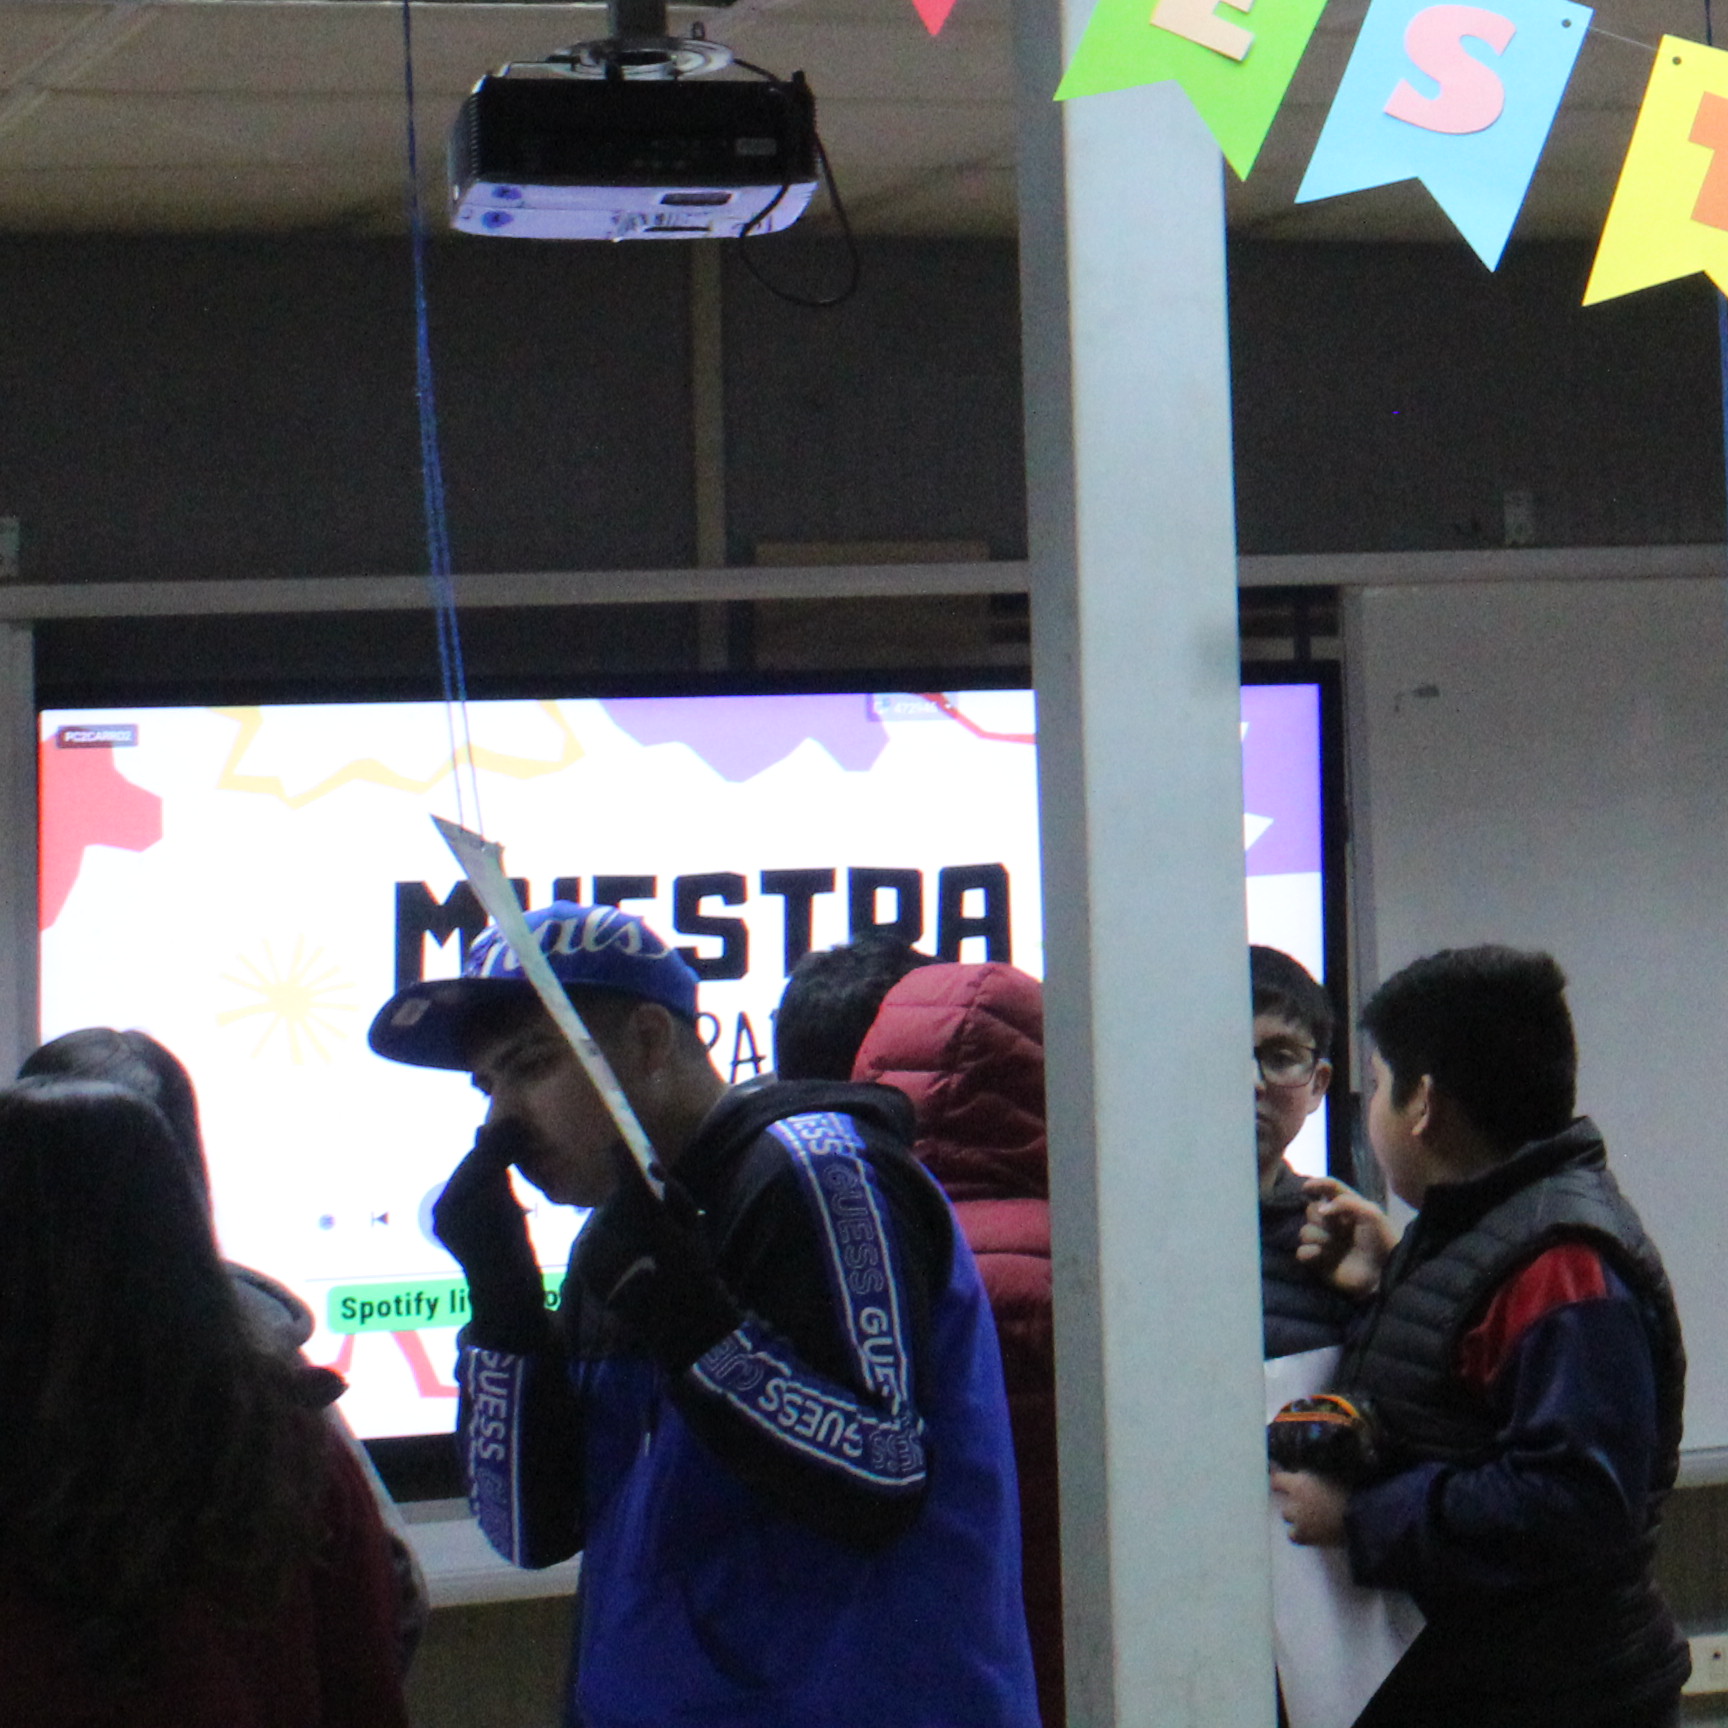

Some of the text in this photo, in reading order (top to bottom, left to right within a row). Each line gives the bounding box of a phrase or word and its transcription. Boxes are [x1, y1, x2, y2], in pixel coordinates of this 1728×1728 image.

[822, 1164, 884, 1296] GUESS
[341, 1291, 439, 1325] Spotify
[757, 1376, 864, 1458] GUESS
